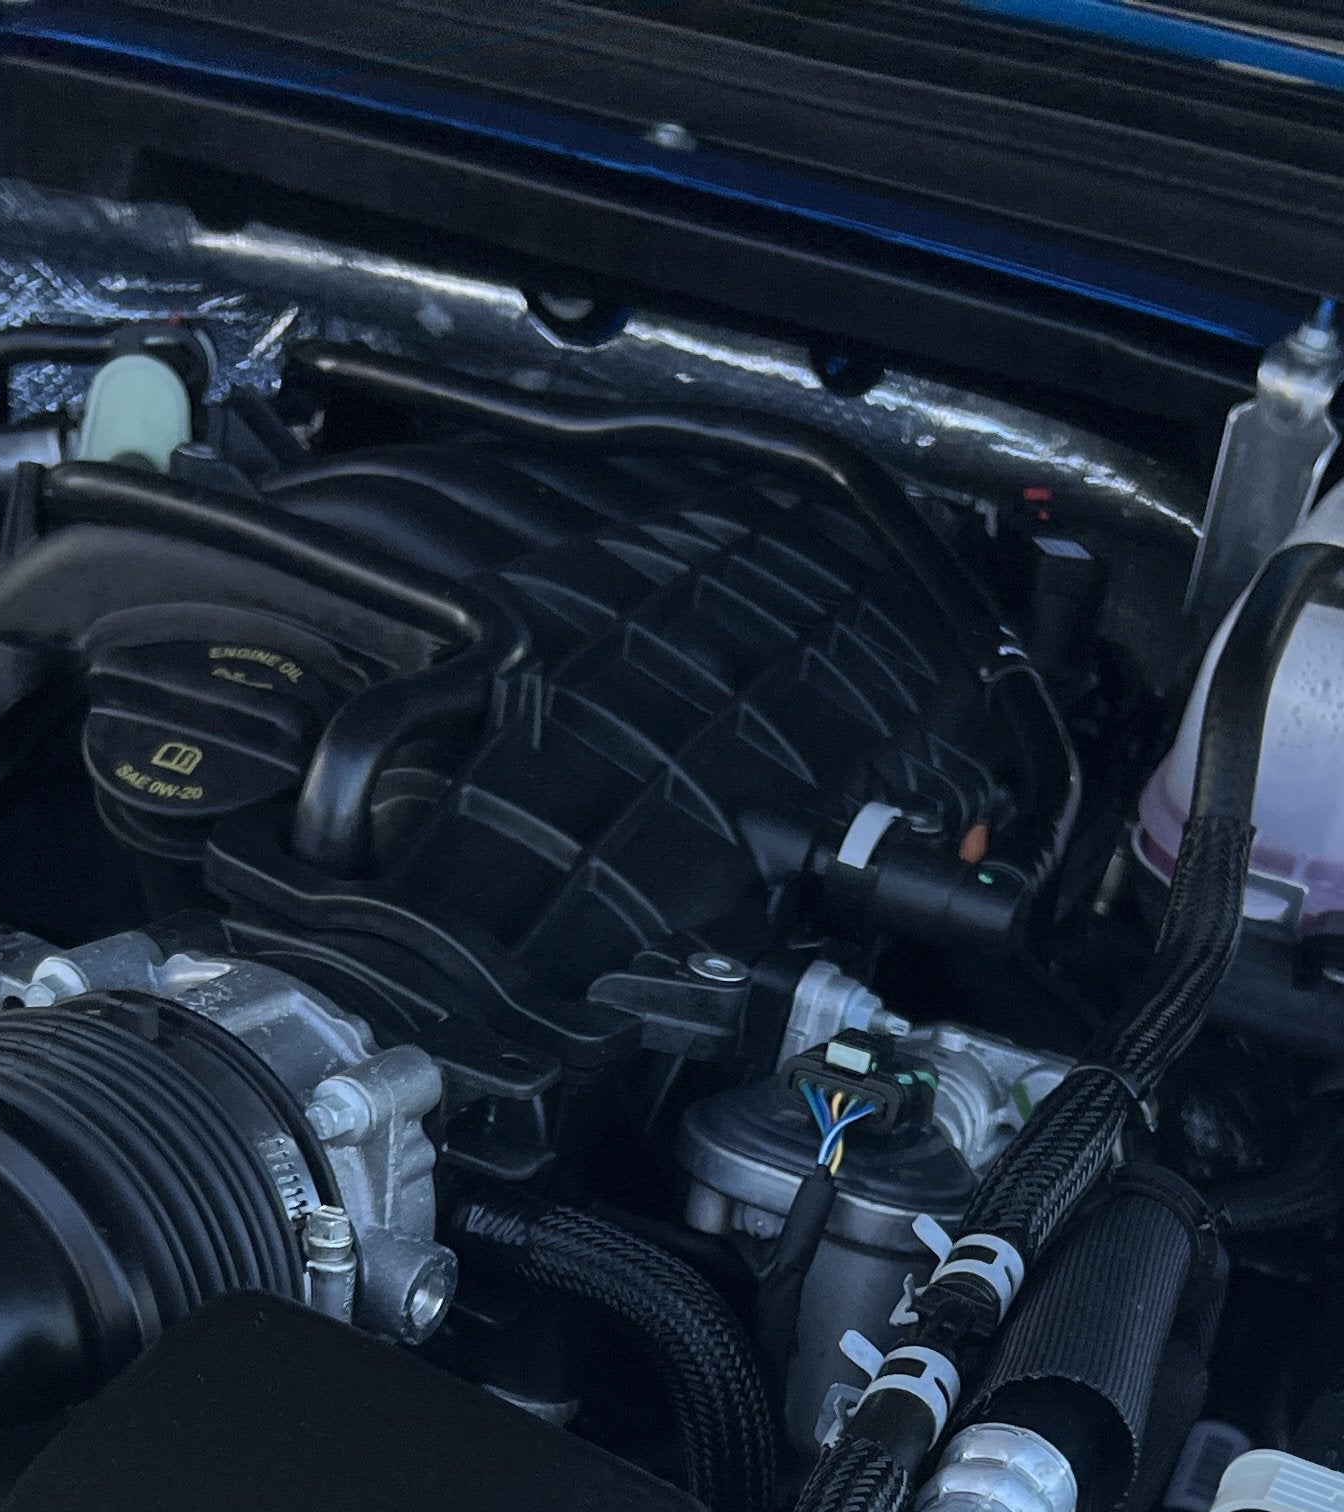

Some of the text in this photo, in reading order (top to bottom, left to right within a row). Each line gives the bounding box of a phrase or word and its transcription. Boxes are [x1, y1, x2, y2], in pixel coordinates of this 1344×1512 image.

[209, 647, 304, 683] ENGINE OIL
[115, 764, 204, 799] SAE 0W-20
